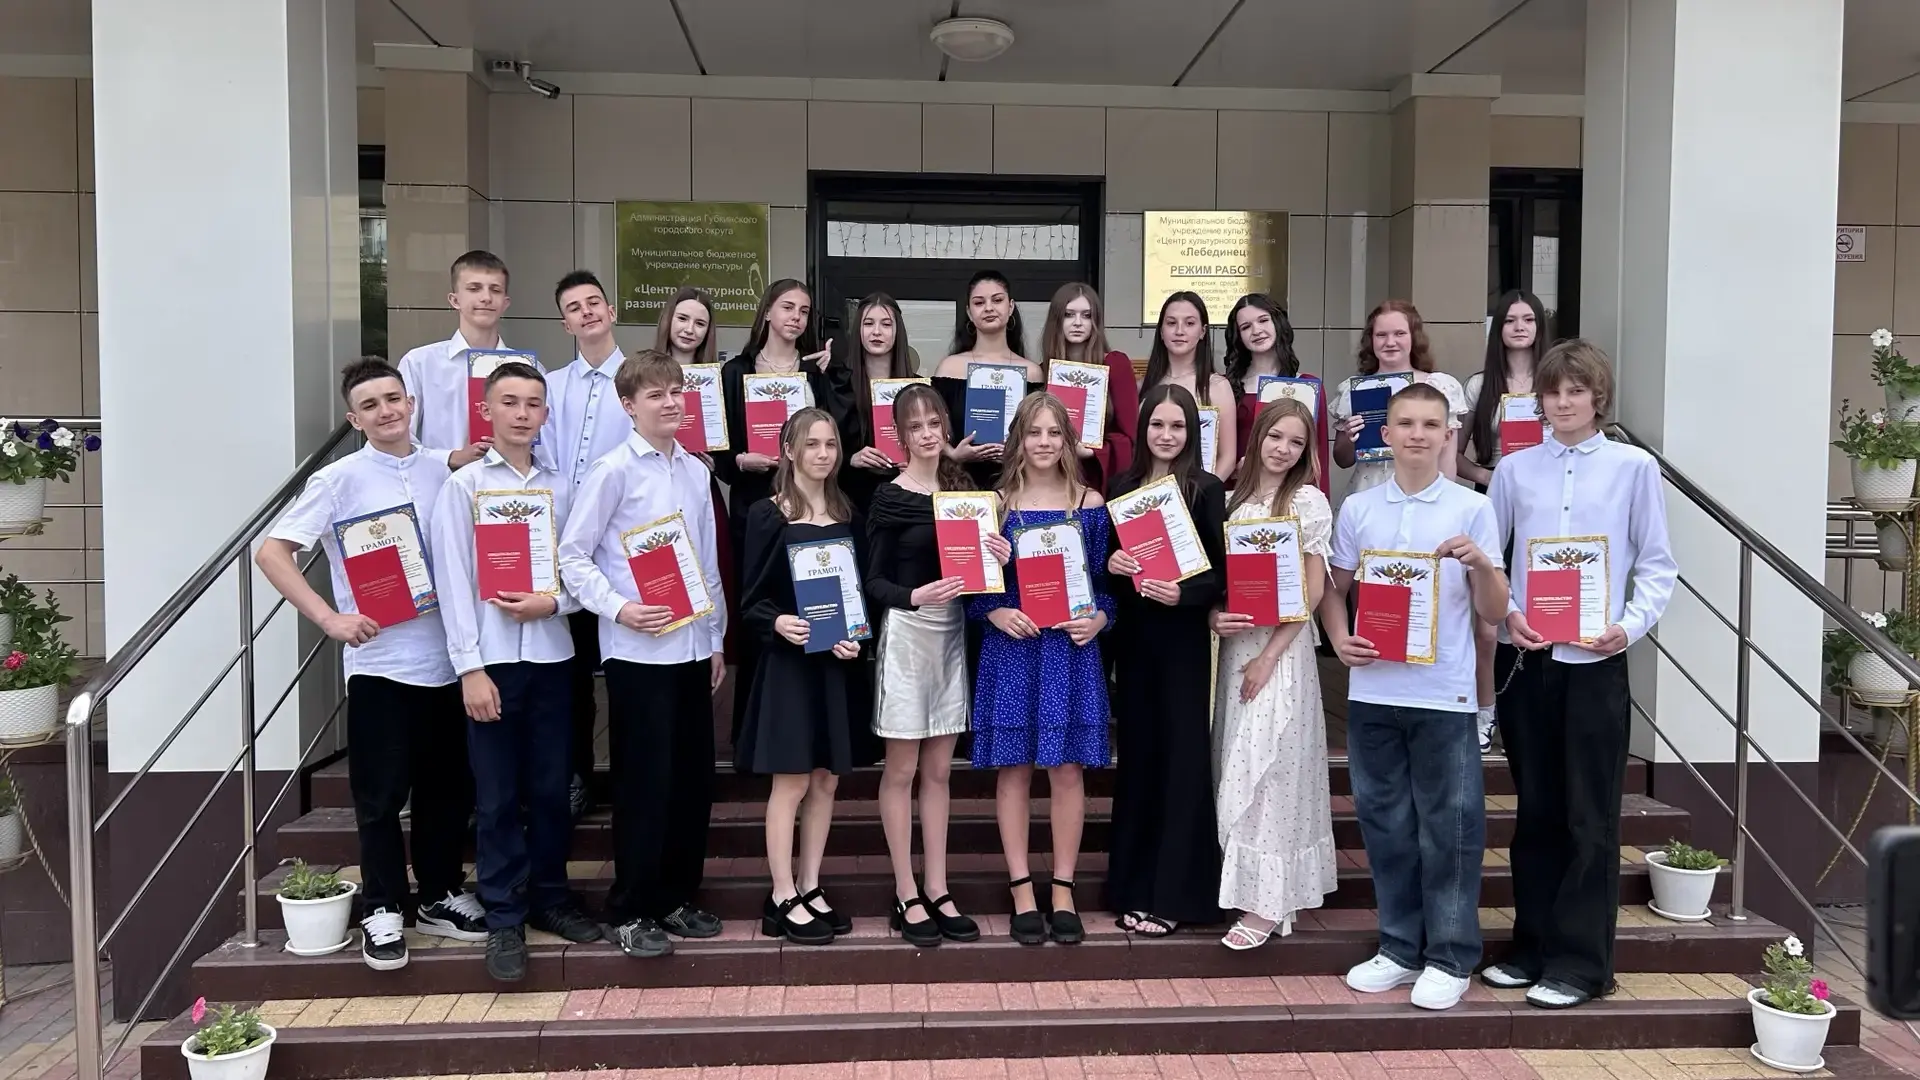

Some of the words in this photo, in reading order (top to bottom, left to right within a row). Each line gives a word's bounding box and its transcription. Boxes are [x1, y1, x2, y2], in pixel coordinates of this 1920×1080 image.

[629, 212, 702, 224] Администрация
[1159, 216, 1225, 227] Муниципальное
[654, 226, 703, 236] городского
[705, 227, 734, 237] округа
[1172, 228, 1222, 237] учреждение
[1157, 237, 1187, 246] «Центр
[1188, 238, 1237, 246] культурного
[631, 247, 704, 260] Муниципальное
[706, 248, 757, 260] бюджетное
[645, 260, 700, 271] учреждение
[702, 261, 743, 272] культуры
[1170, 265, 1212, 275] РЕЖИМ
[634, 283, 678, 296] «Центр
[625, 299, 667, 311] развит
[360, 535, 403, 553] ГРАМОТА
[1032, 546, 1070, 558] ГРАМОТА
[807, 565, 844, 577] ГРАМОТА
